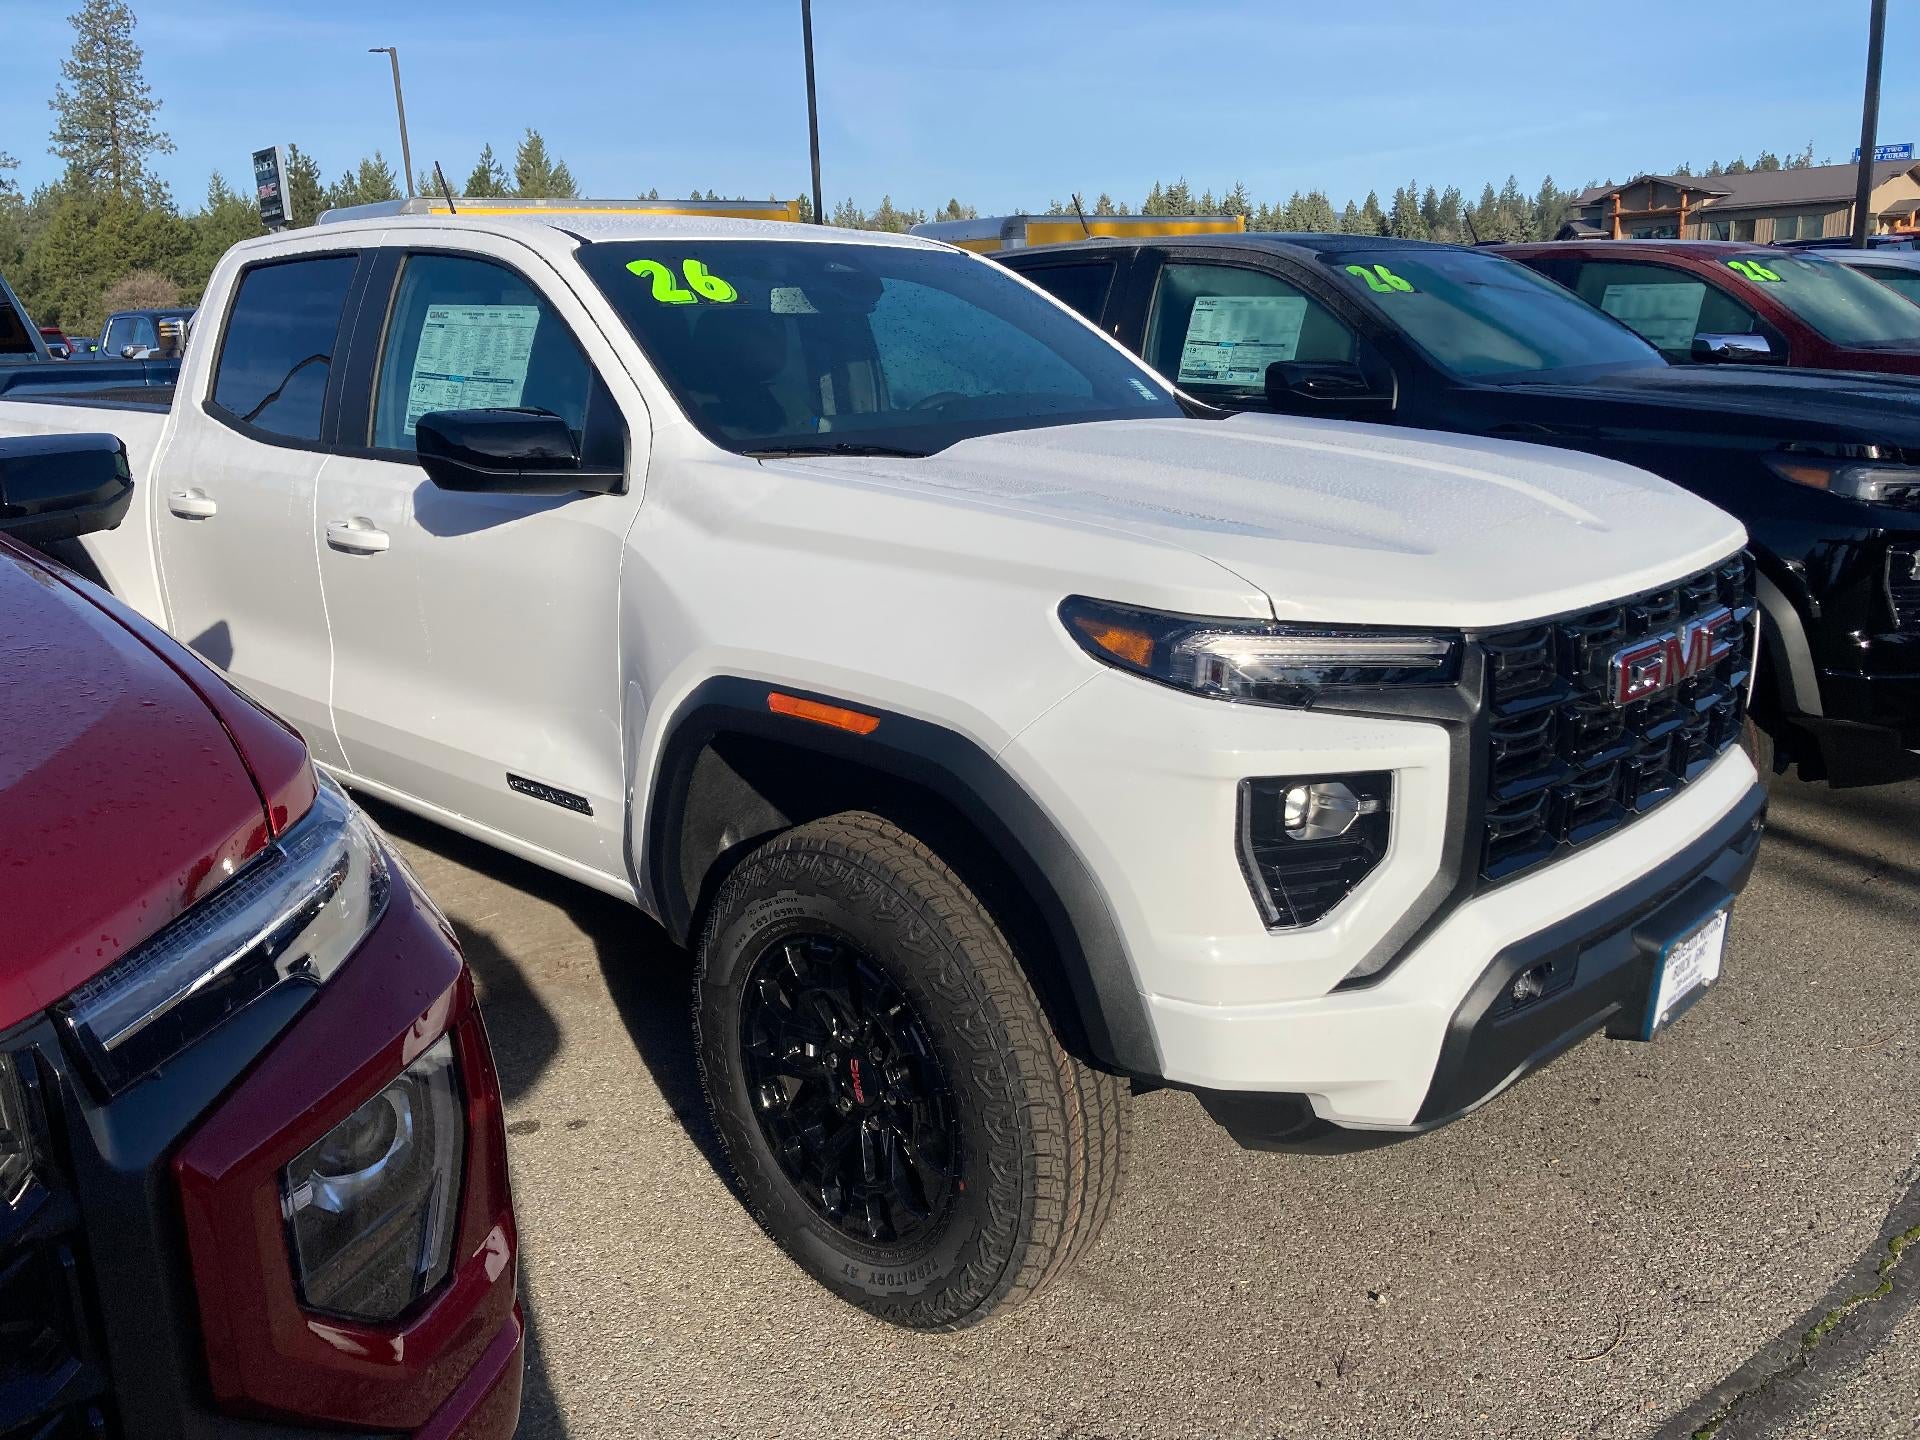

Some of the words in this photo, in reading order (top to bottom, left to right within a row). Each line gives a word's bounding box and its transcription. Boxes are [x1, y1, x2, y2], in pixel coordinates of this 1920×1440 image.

[1883, 152, 1909, 160] TURNS
[625, 258, 738, 305] 26
[1345, 264, 1415, 293] 26
[1727, 260, 1781, 283] 26
[429, 311, 449, 319] GMC
[1609, 608, 1733, 708] GMC
[850, 1058, 865, 1104] GMC
[867, 1257, 940, 1287] TERRITORY
